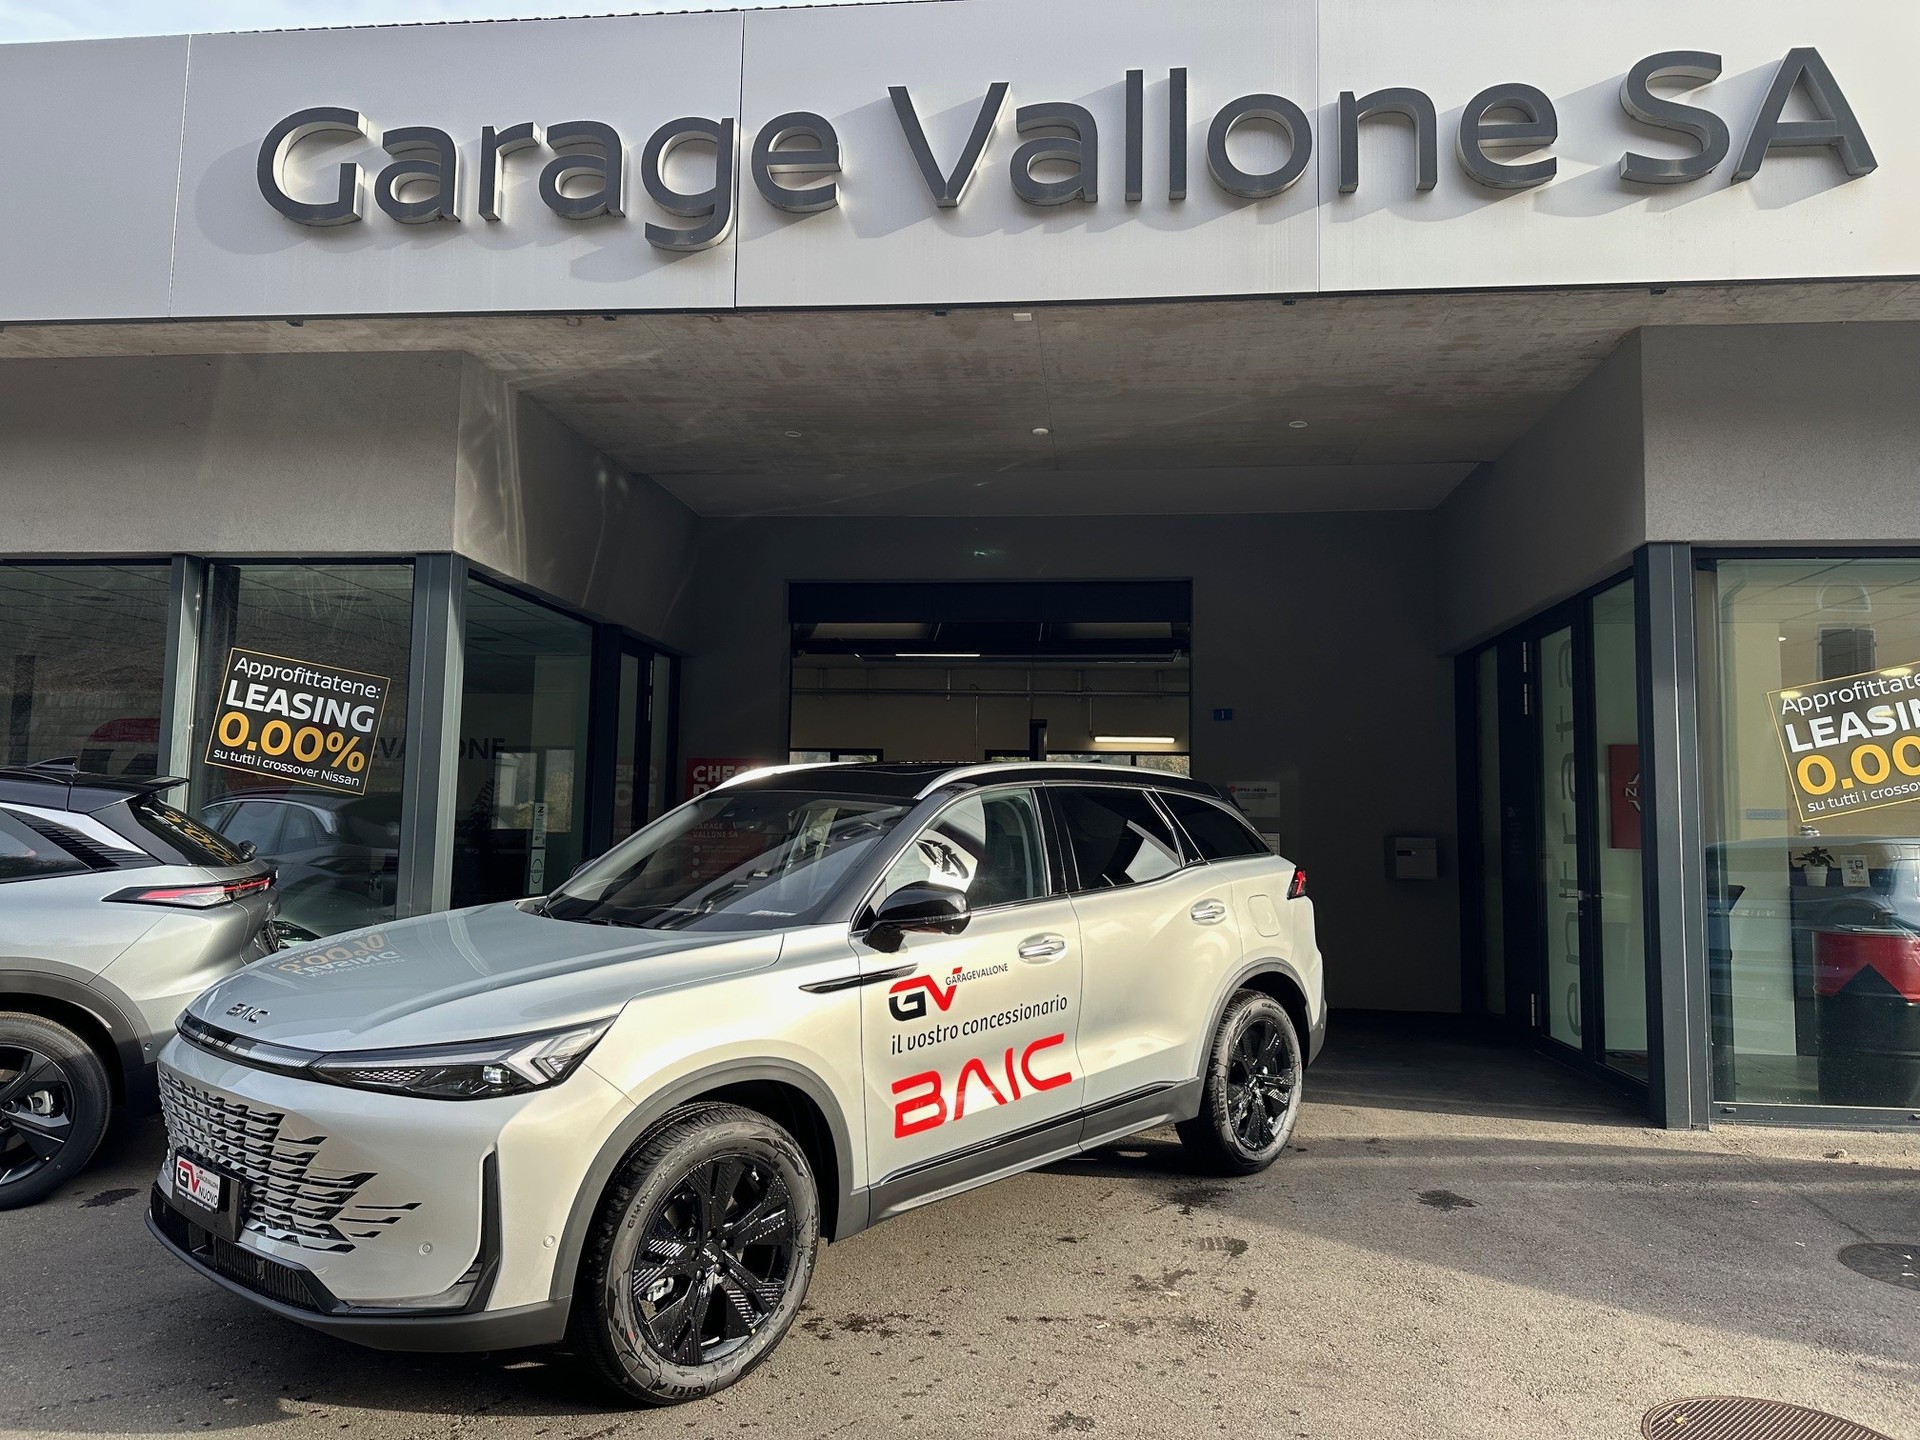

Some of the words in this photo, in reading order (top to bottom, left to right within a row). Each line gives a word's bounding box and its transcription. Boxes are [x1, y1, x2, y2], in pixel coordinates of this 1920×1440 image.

[256, 105, 843, 252] Garage
[887, 66, 1559, 208] Vallone
[1618, 46, 1879, 185] SA
[233, 656, 381, 699] Approfittatene:
[225, 679, 375, 733] LEASING
[213, 749, 228, 760] su
[230, 750, 256, 766] tutti
[263, 759, 319, 778] crossover
[320, 769, 360, 787] Nissan
[218, 711, 365, 773] 0.00%
[1807, 801, 1826, 813] su
[1828, 791, 1859, 809] tutti
[1863, 790, 1867, 801] i
[945, 963, 1009, 986] GARAGEVALLONE
[891, 1034, 902, 1055] il
[907, 1024, 958, 1051] vostro
[962, 994, 1068, 1036] concessionario
[891, 1033, 1073, 1139] BAIC
